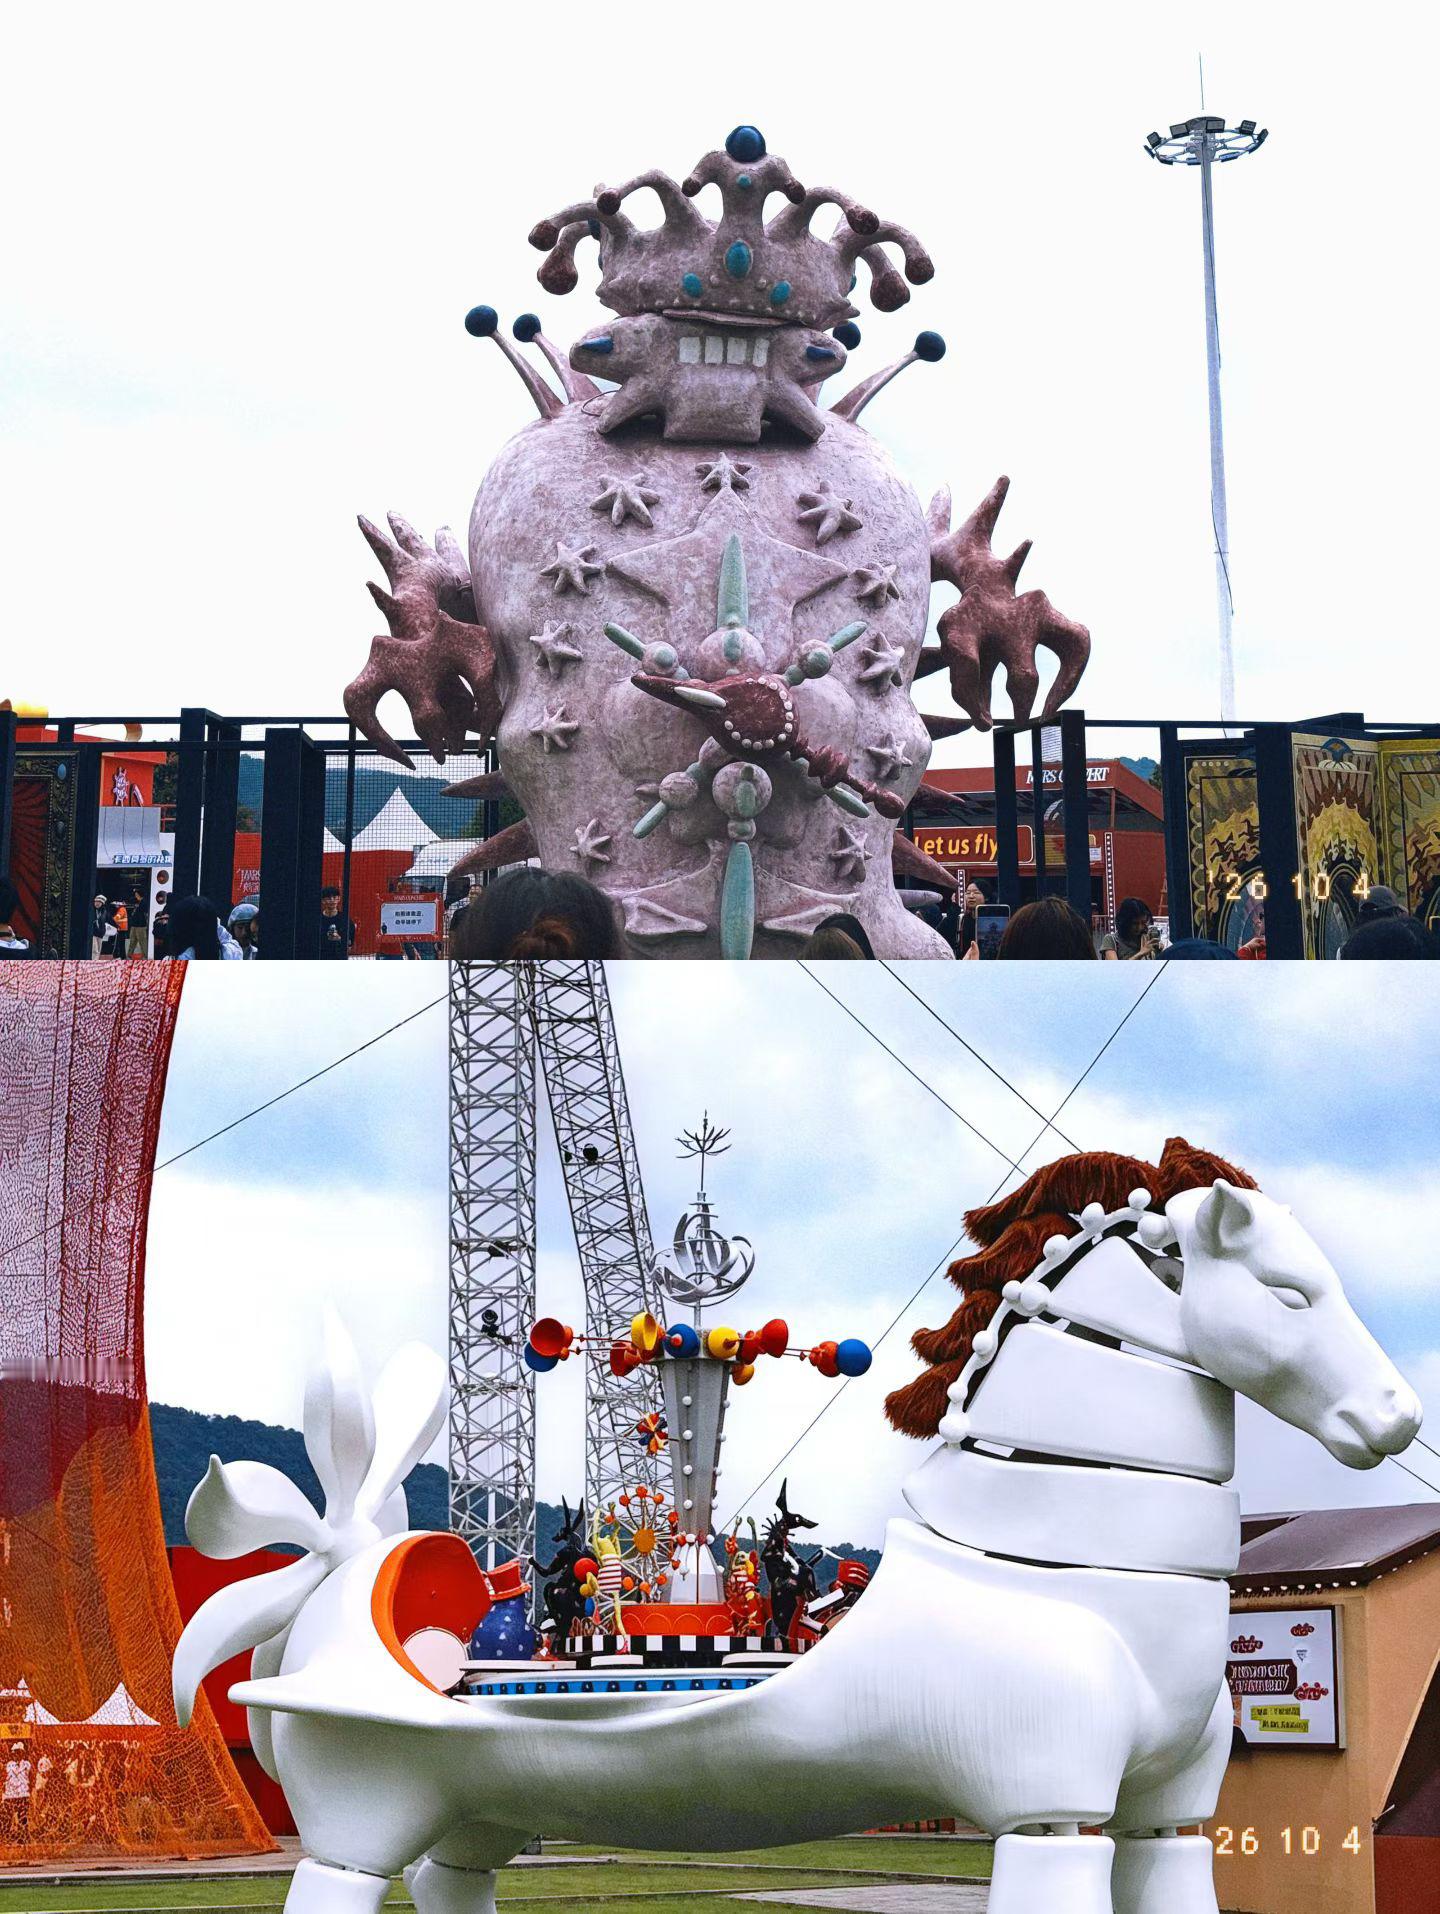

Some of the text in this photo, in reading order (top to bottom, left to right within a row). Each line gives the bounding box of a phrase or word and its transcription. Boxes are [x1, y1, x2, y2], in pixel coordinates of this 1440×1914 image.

[1026, 769, 1057, 785] MRS
[948, 838, 970, 855] us
[975, 833, 998, 861] fly
